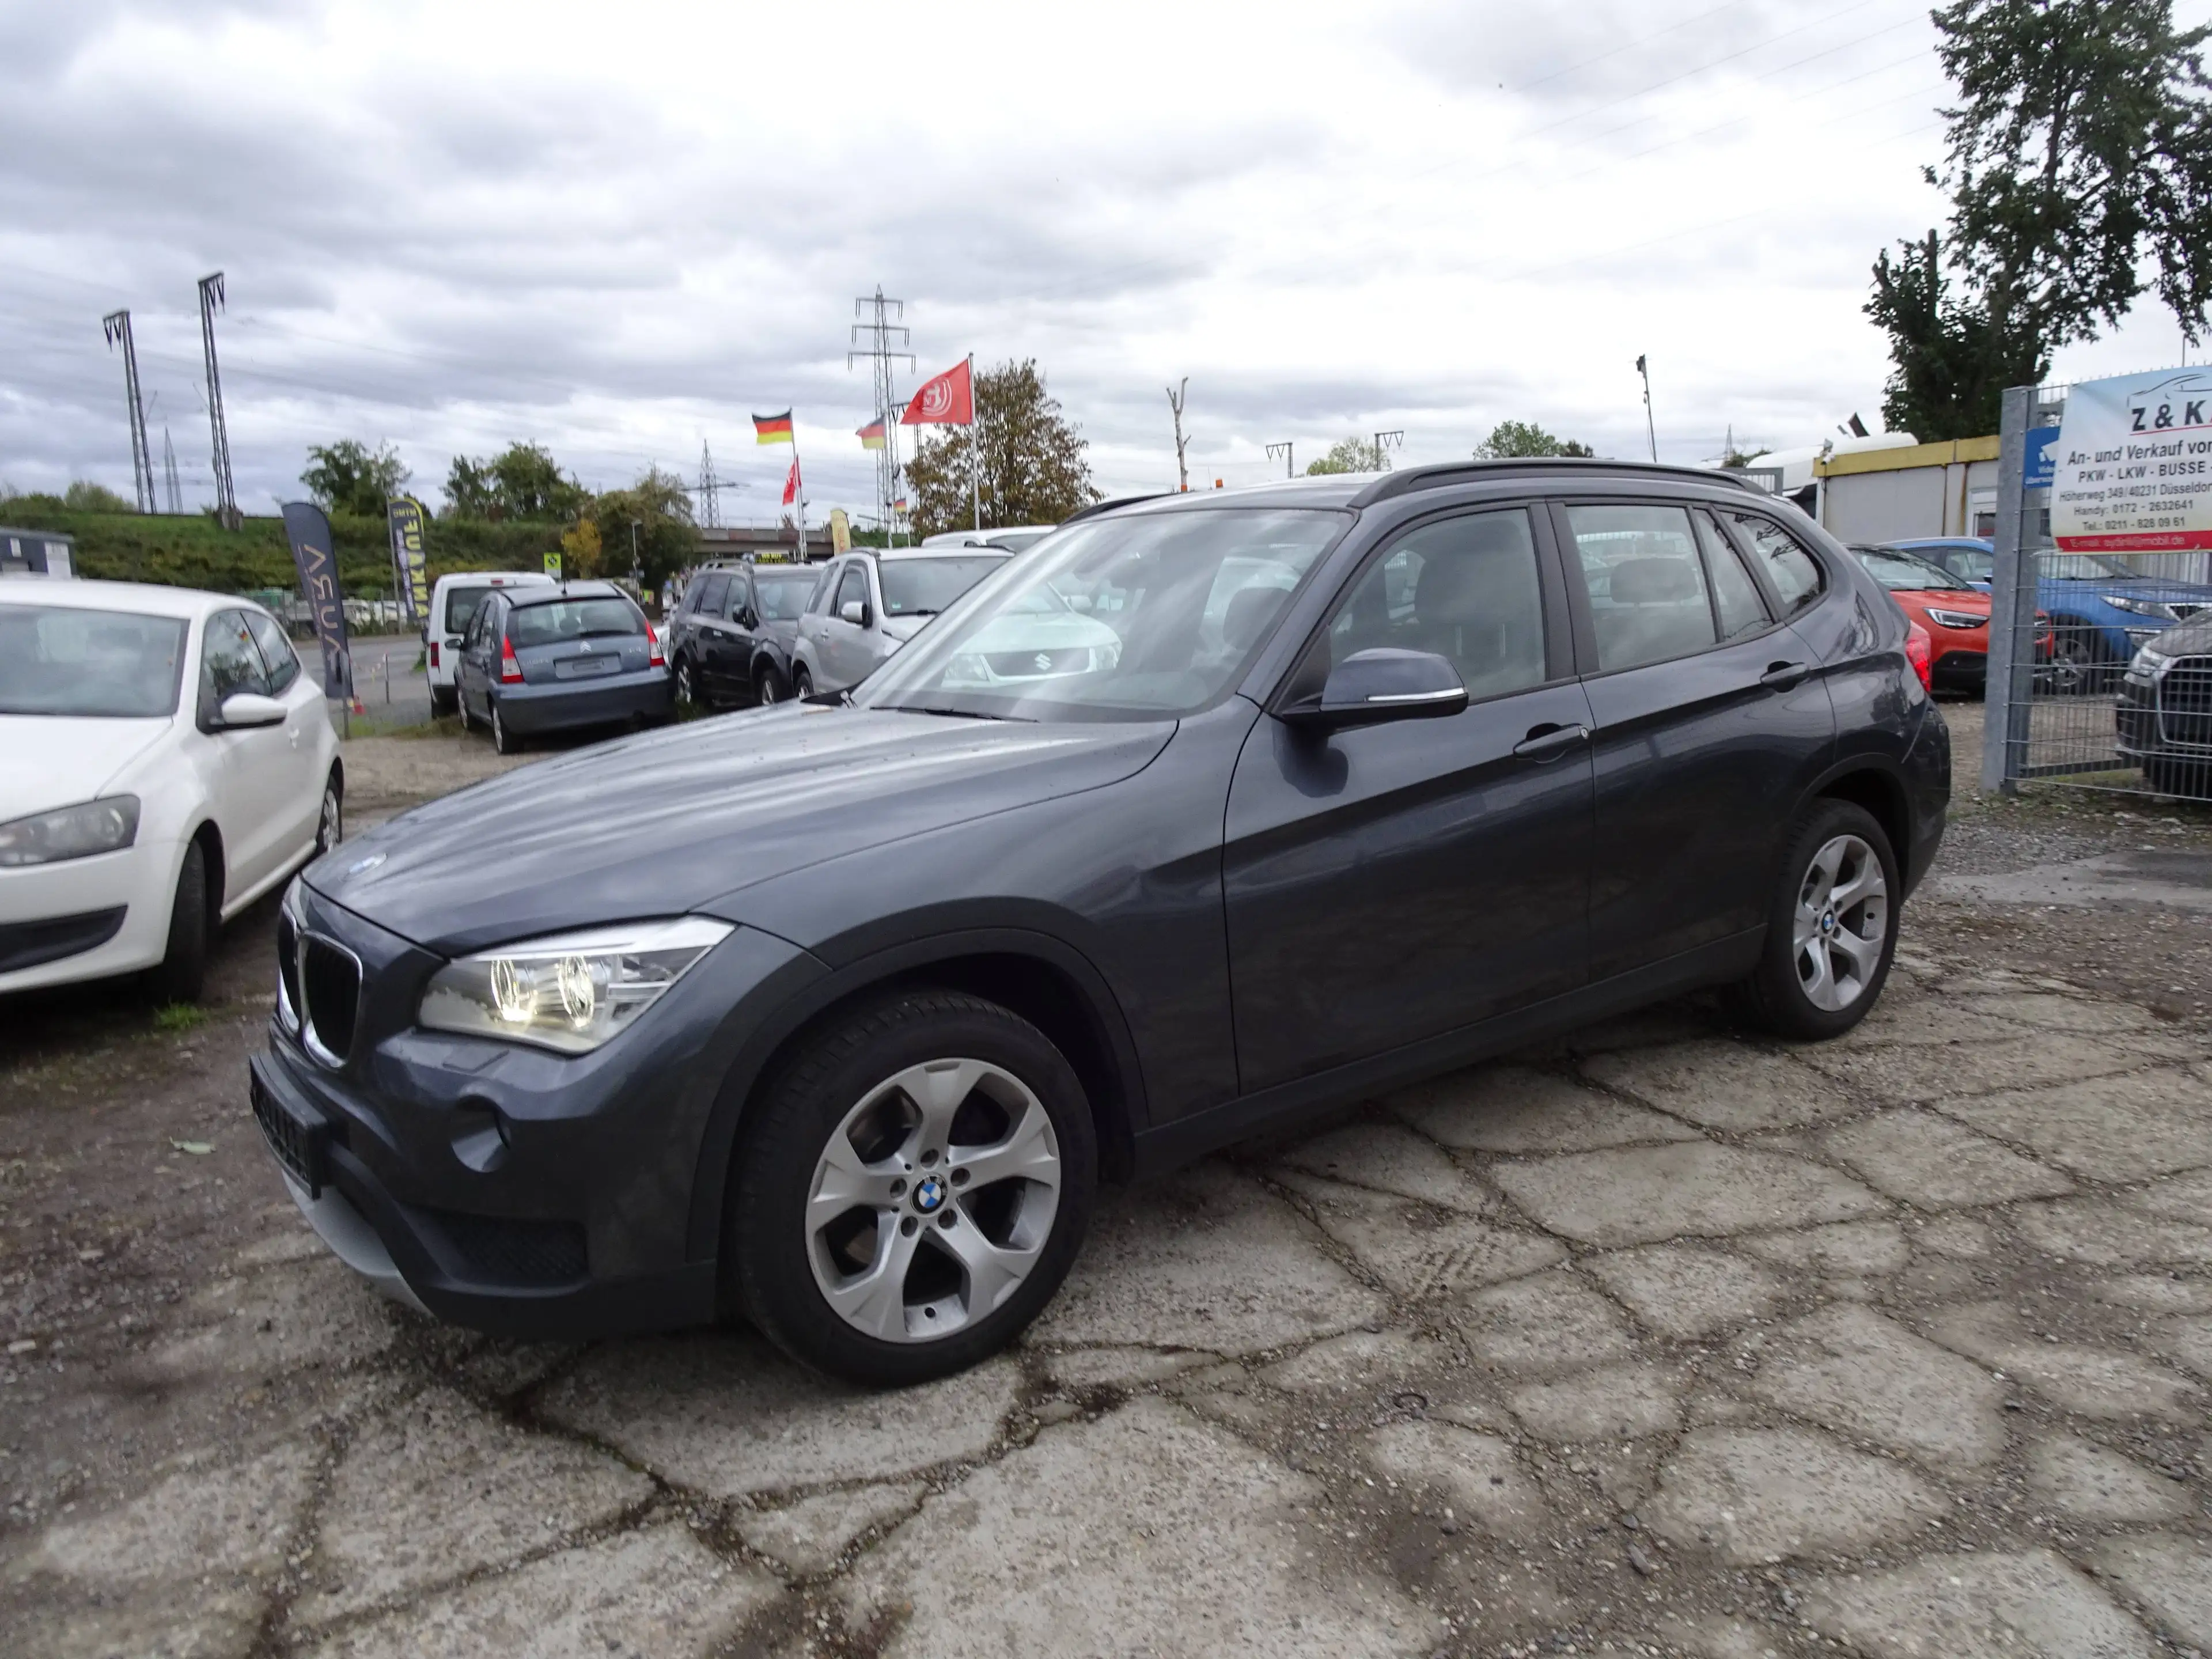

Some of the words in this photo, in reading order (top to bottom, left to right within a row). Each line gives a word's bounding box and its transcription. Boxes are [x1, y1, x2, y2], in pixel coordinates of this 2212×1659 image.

[2132, 407, 2146, 431] Z
[2155, 404, 2175, 429] &
[2184, 400, 2207, 426] K
[2067, 451, 2091, 466] An-
[2095, 446, 2123, 463] und
[2127, 440, 2184, 460] Verkauf
[2078, 469, 2106, 483] PKW
[2118, 466, 2147, 480] LKW
[2159, 461, 2206, 476] BUSSE
